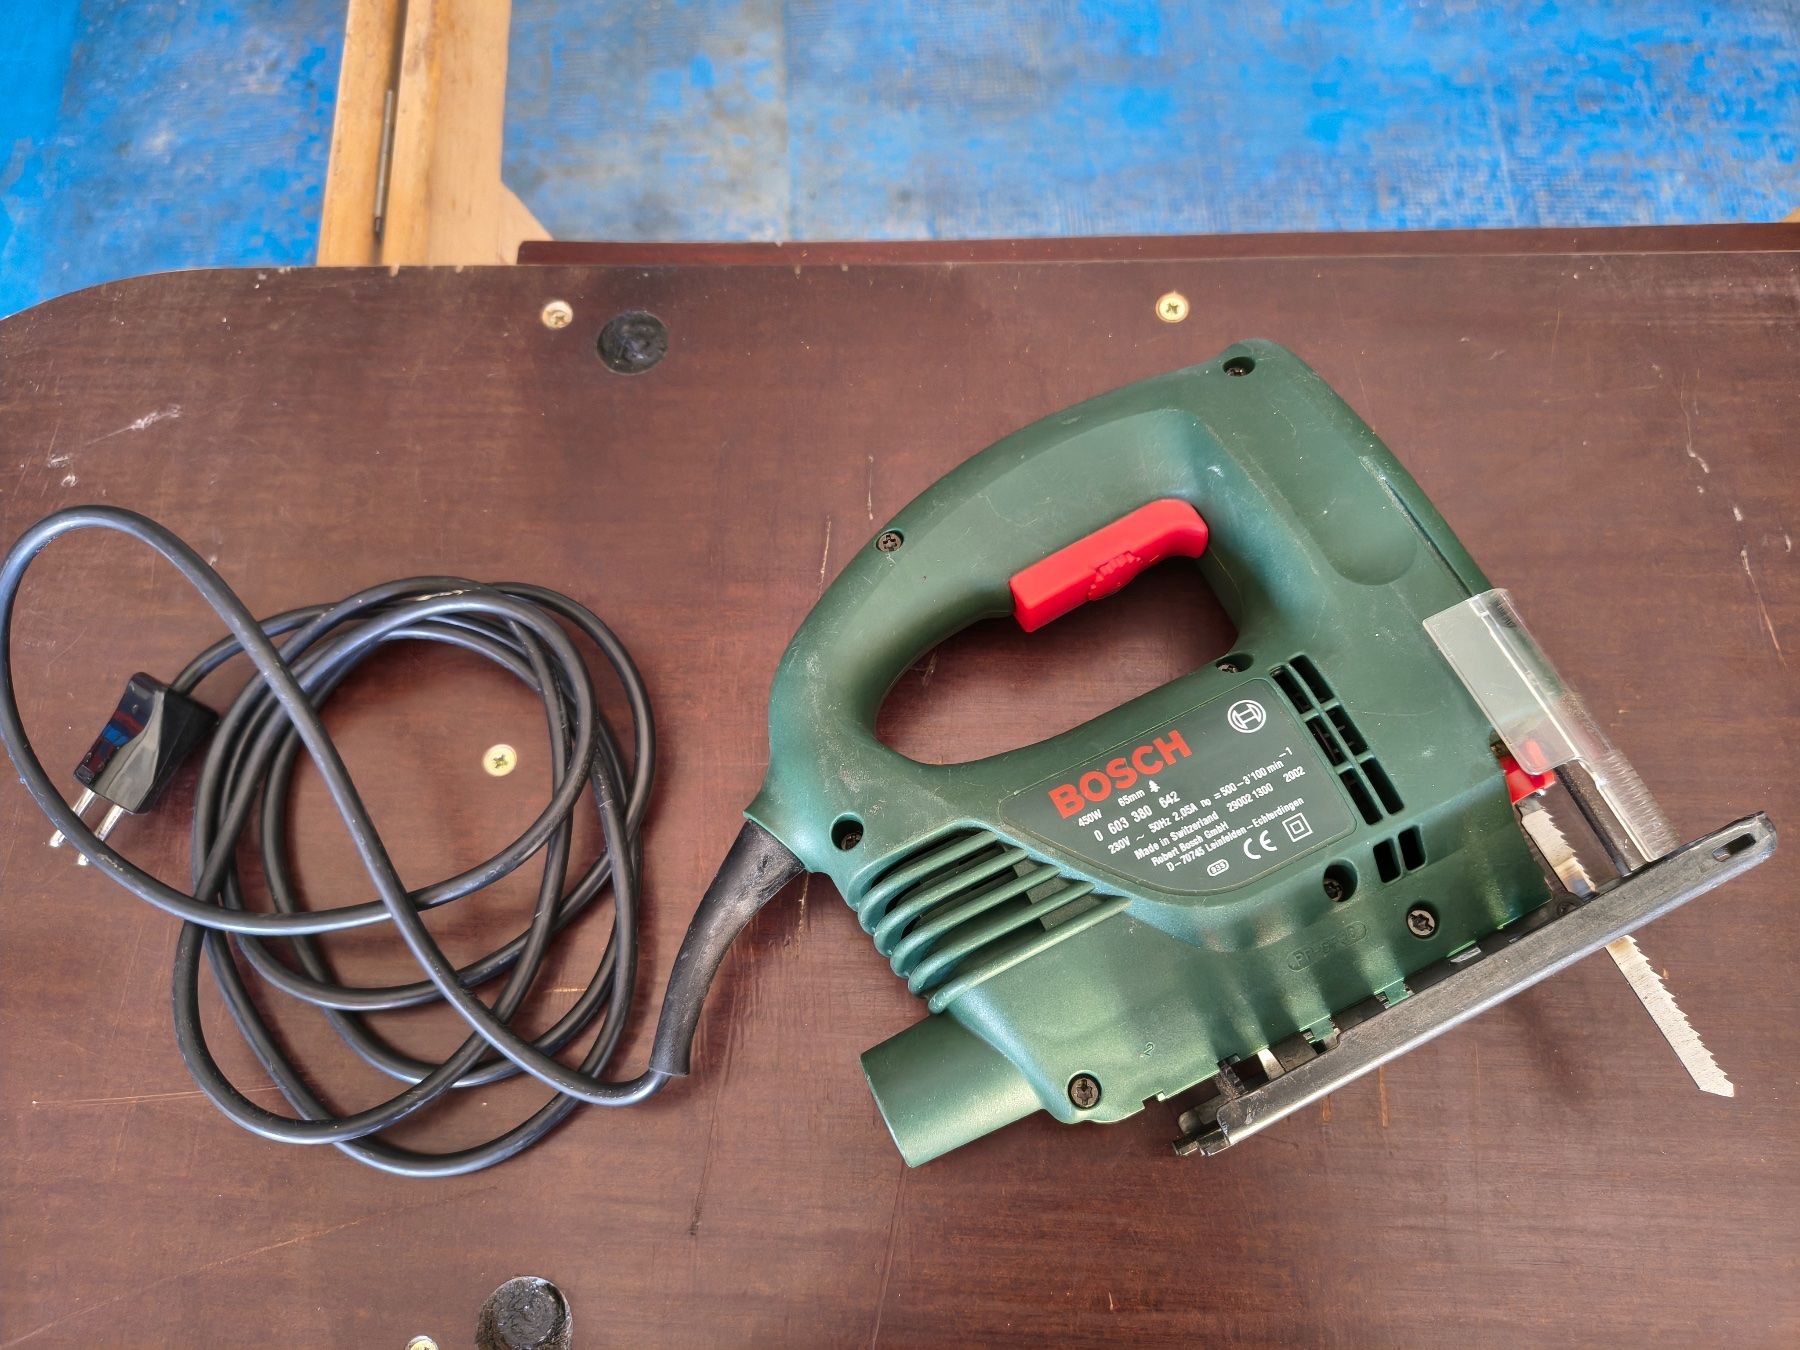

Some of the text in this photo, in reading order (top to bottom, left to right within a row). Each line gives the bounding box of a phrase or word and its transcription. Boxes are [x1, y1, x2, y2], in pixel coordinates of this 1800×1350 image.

[1047, 728, 1193, 820] BOSCH
[1078, 789, 1146, 827] 450W 65mm
[1093, 790, 1181, 842] 0 603 380 642
[1107, 835, 1131, 855] 230V
[1147, 817, 1173, 834] 50Hz
[1171, 802, 1199, 821] 2,05A
[1133, 841, 1160, 860] Made
[1158, 836, 1171, 847] in
[1169, 810, 1220, 842] Switzerland
[1251, 782, 1274, 799] 1300
[1282, 765, 1306, 783] 2002
[1150, 820, 1229, 867] Robert Bosch GmbH
